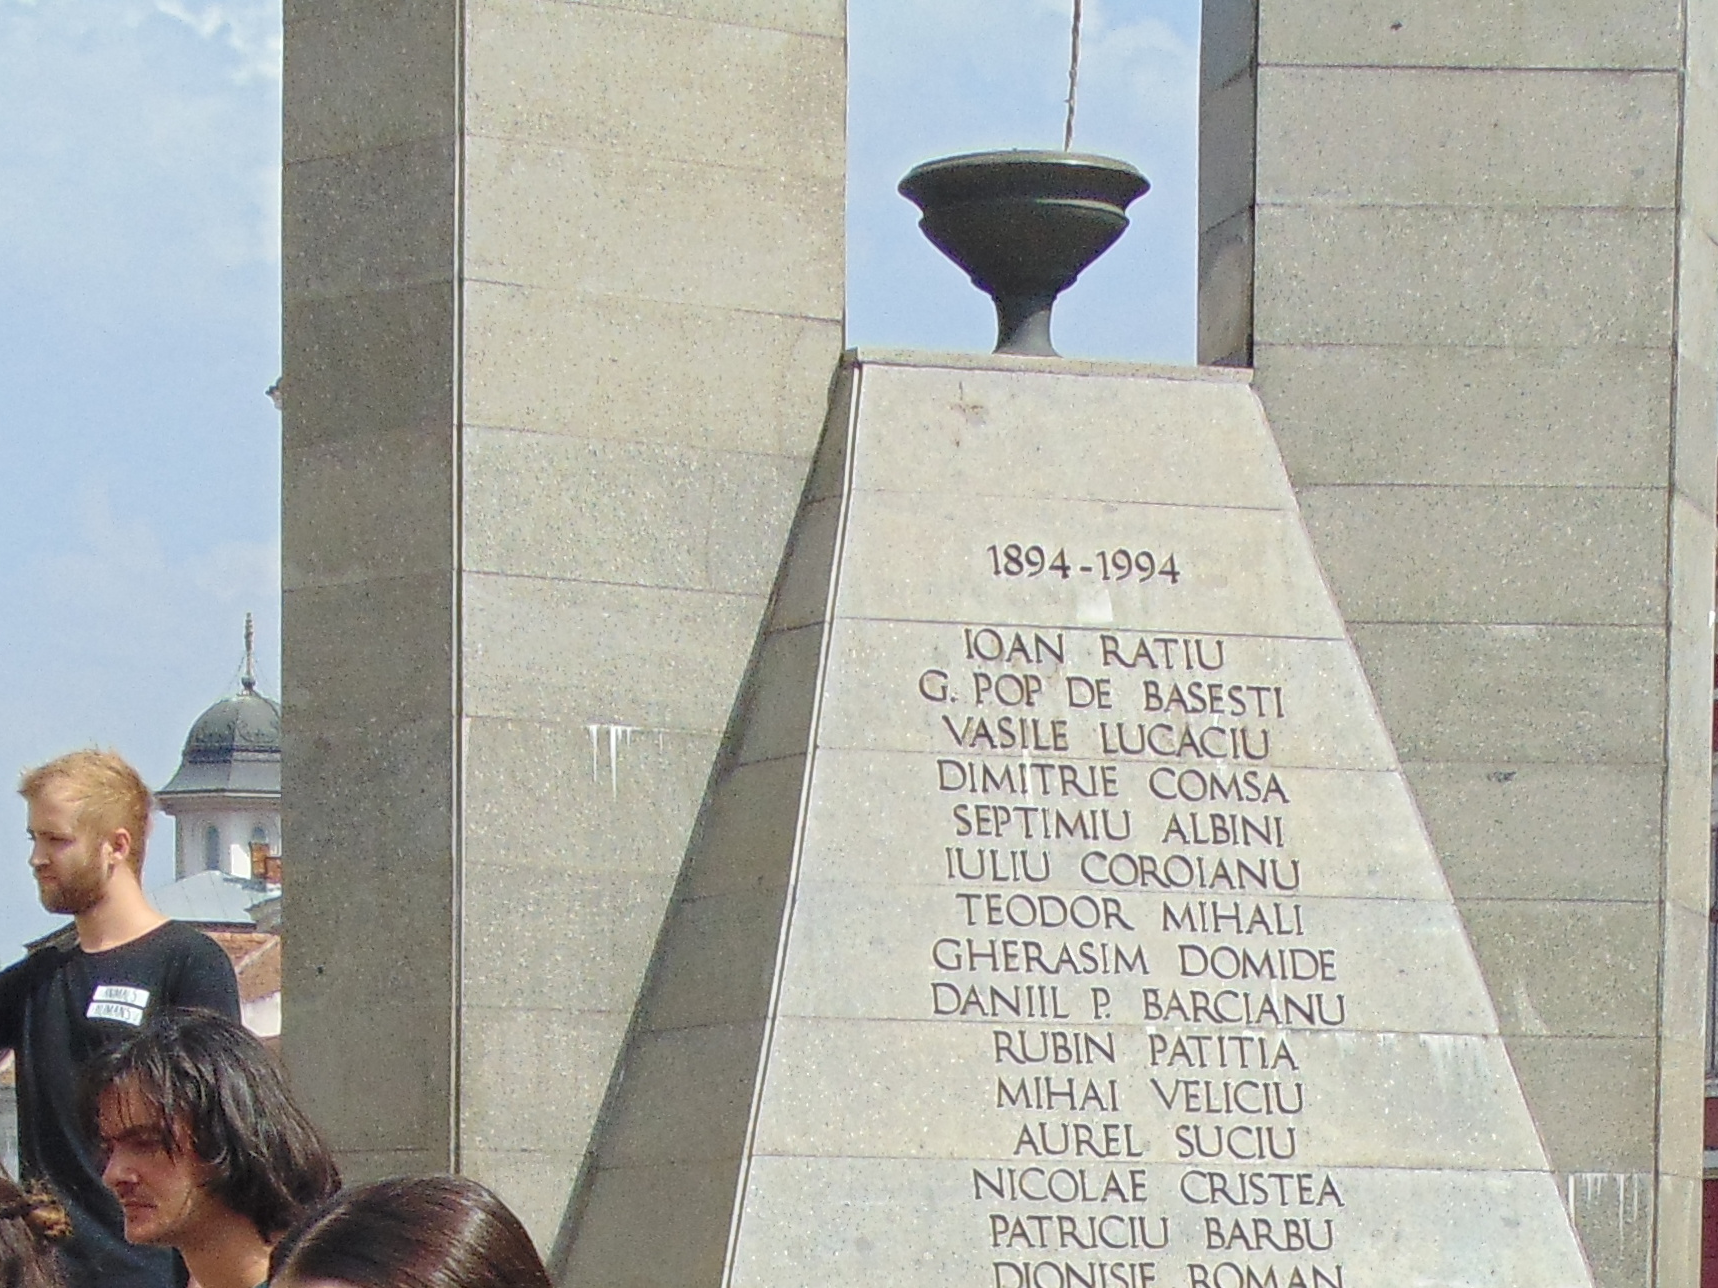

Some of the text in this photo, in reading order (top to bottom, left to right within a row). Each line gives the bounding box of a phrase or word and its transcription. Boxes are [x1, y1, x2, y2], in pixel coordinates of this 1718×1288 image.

[964, 627, 1225, 672] IOAN RATIU
[918, 669, 1285, 718] G. POP DE BASESTI
[941, 713, 1270, 760] VASILE LUCACIU
[936, 759, 1291, 804] DIMITRIE COMSA
[953, 804, 1285, 848] SEPTIMIU ALBINI
[944, 846, 1302, 890] IULIU COROIANU
[955, 892, 1304, 937] TEODOR MIHALI
[932, 938, 1337, 982] GHERASIM DOMIDE
[930, 982, 1346, 1026] DANIIL P. BARCIANU
[993, 1030, 1300, 1071] RUBIN PATITIA
[995, 1076, 1304, 1115] MIHAI VELICIU
[1013, 1122, 1296, 1160] AUREL SUCIU
[972, 1168, 1345, 1207] NICOLAE CRISTEA
[988, 1214, 1334, 1252] PATRICIU BARBU
